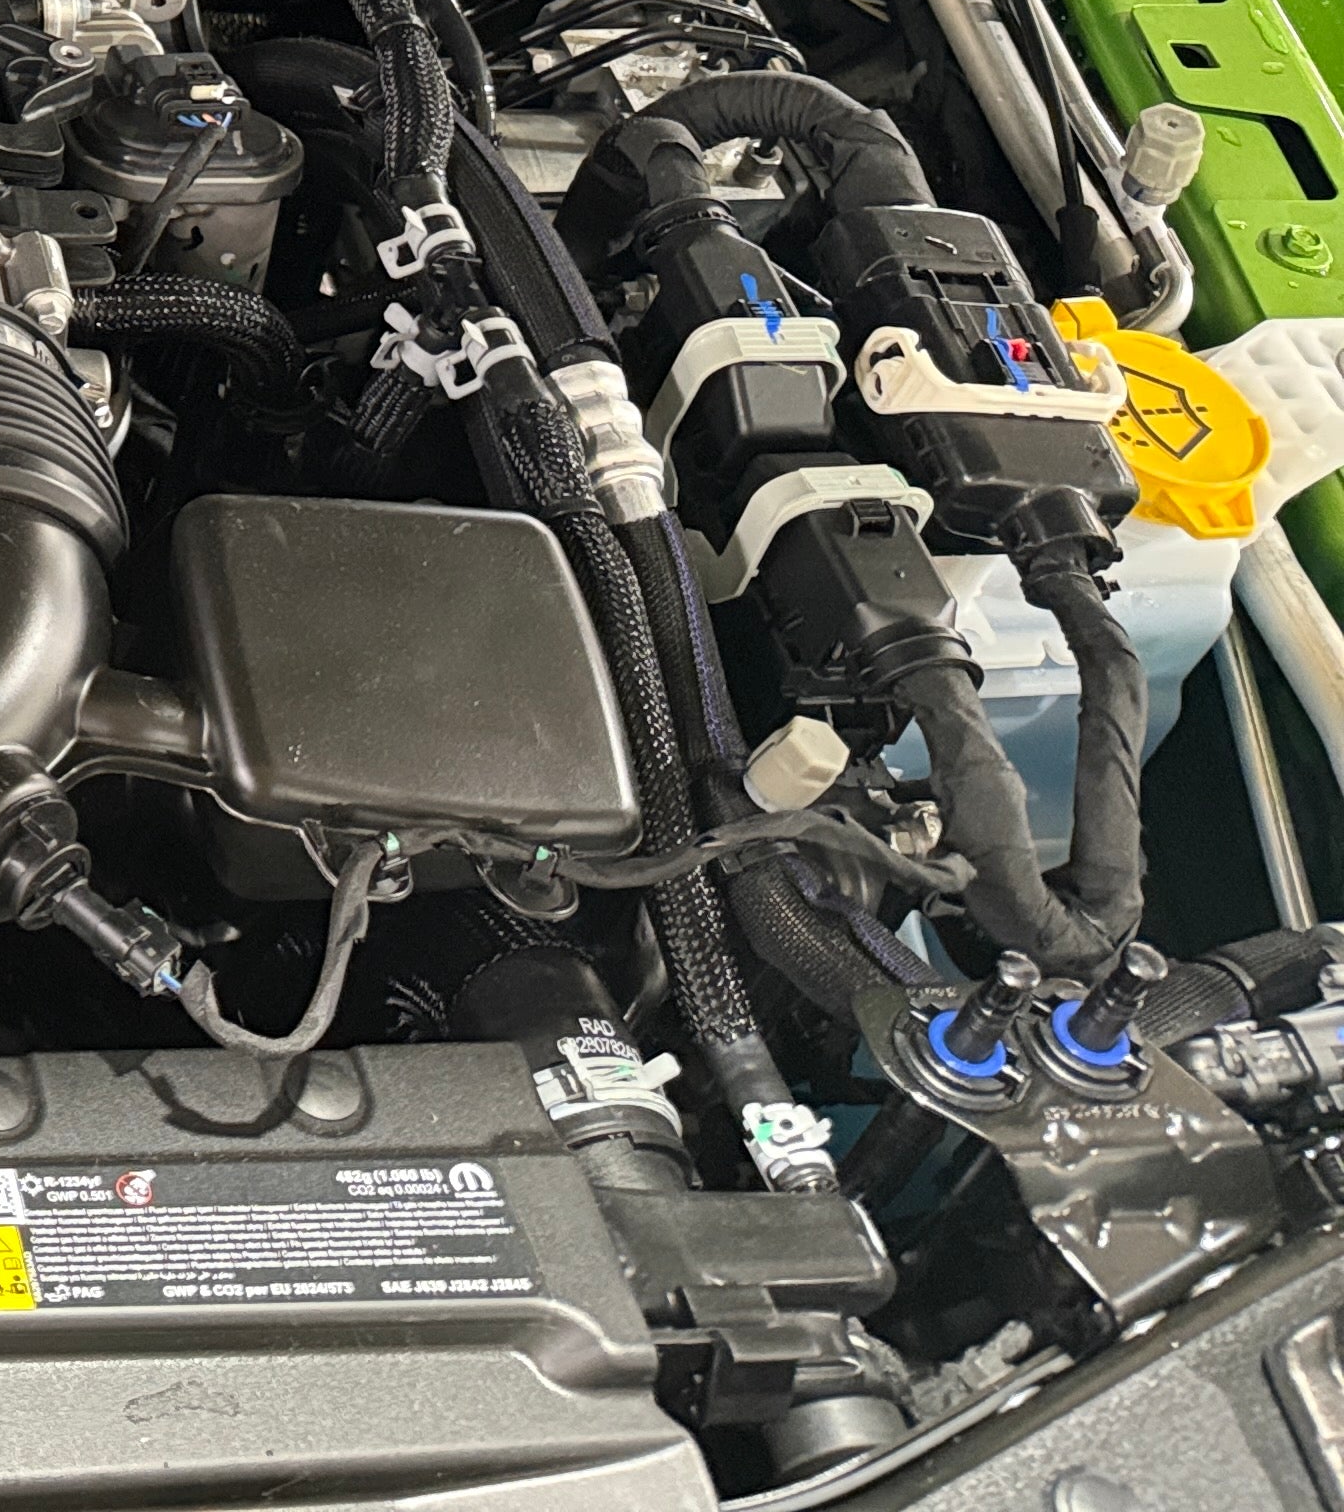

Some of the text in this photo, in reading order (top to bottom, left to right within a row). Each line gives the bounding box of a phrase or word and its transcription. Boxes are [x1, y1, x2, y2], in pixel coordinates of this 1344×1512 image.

[578, 1017, 616, 1037] RAD
[46, 1190, 114, 1202] GWP 0.501
[348, 1185, 377, 1196] CO2
[72, 1286, 106, 1299] PAG
[163, 1285, 198, 1298] GWP
